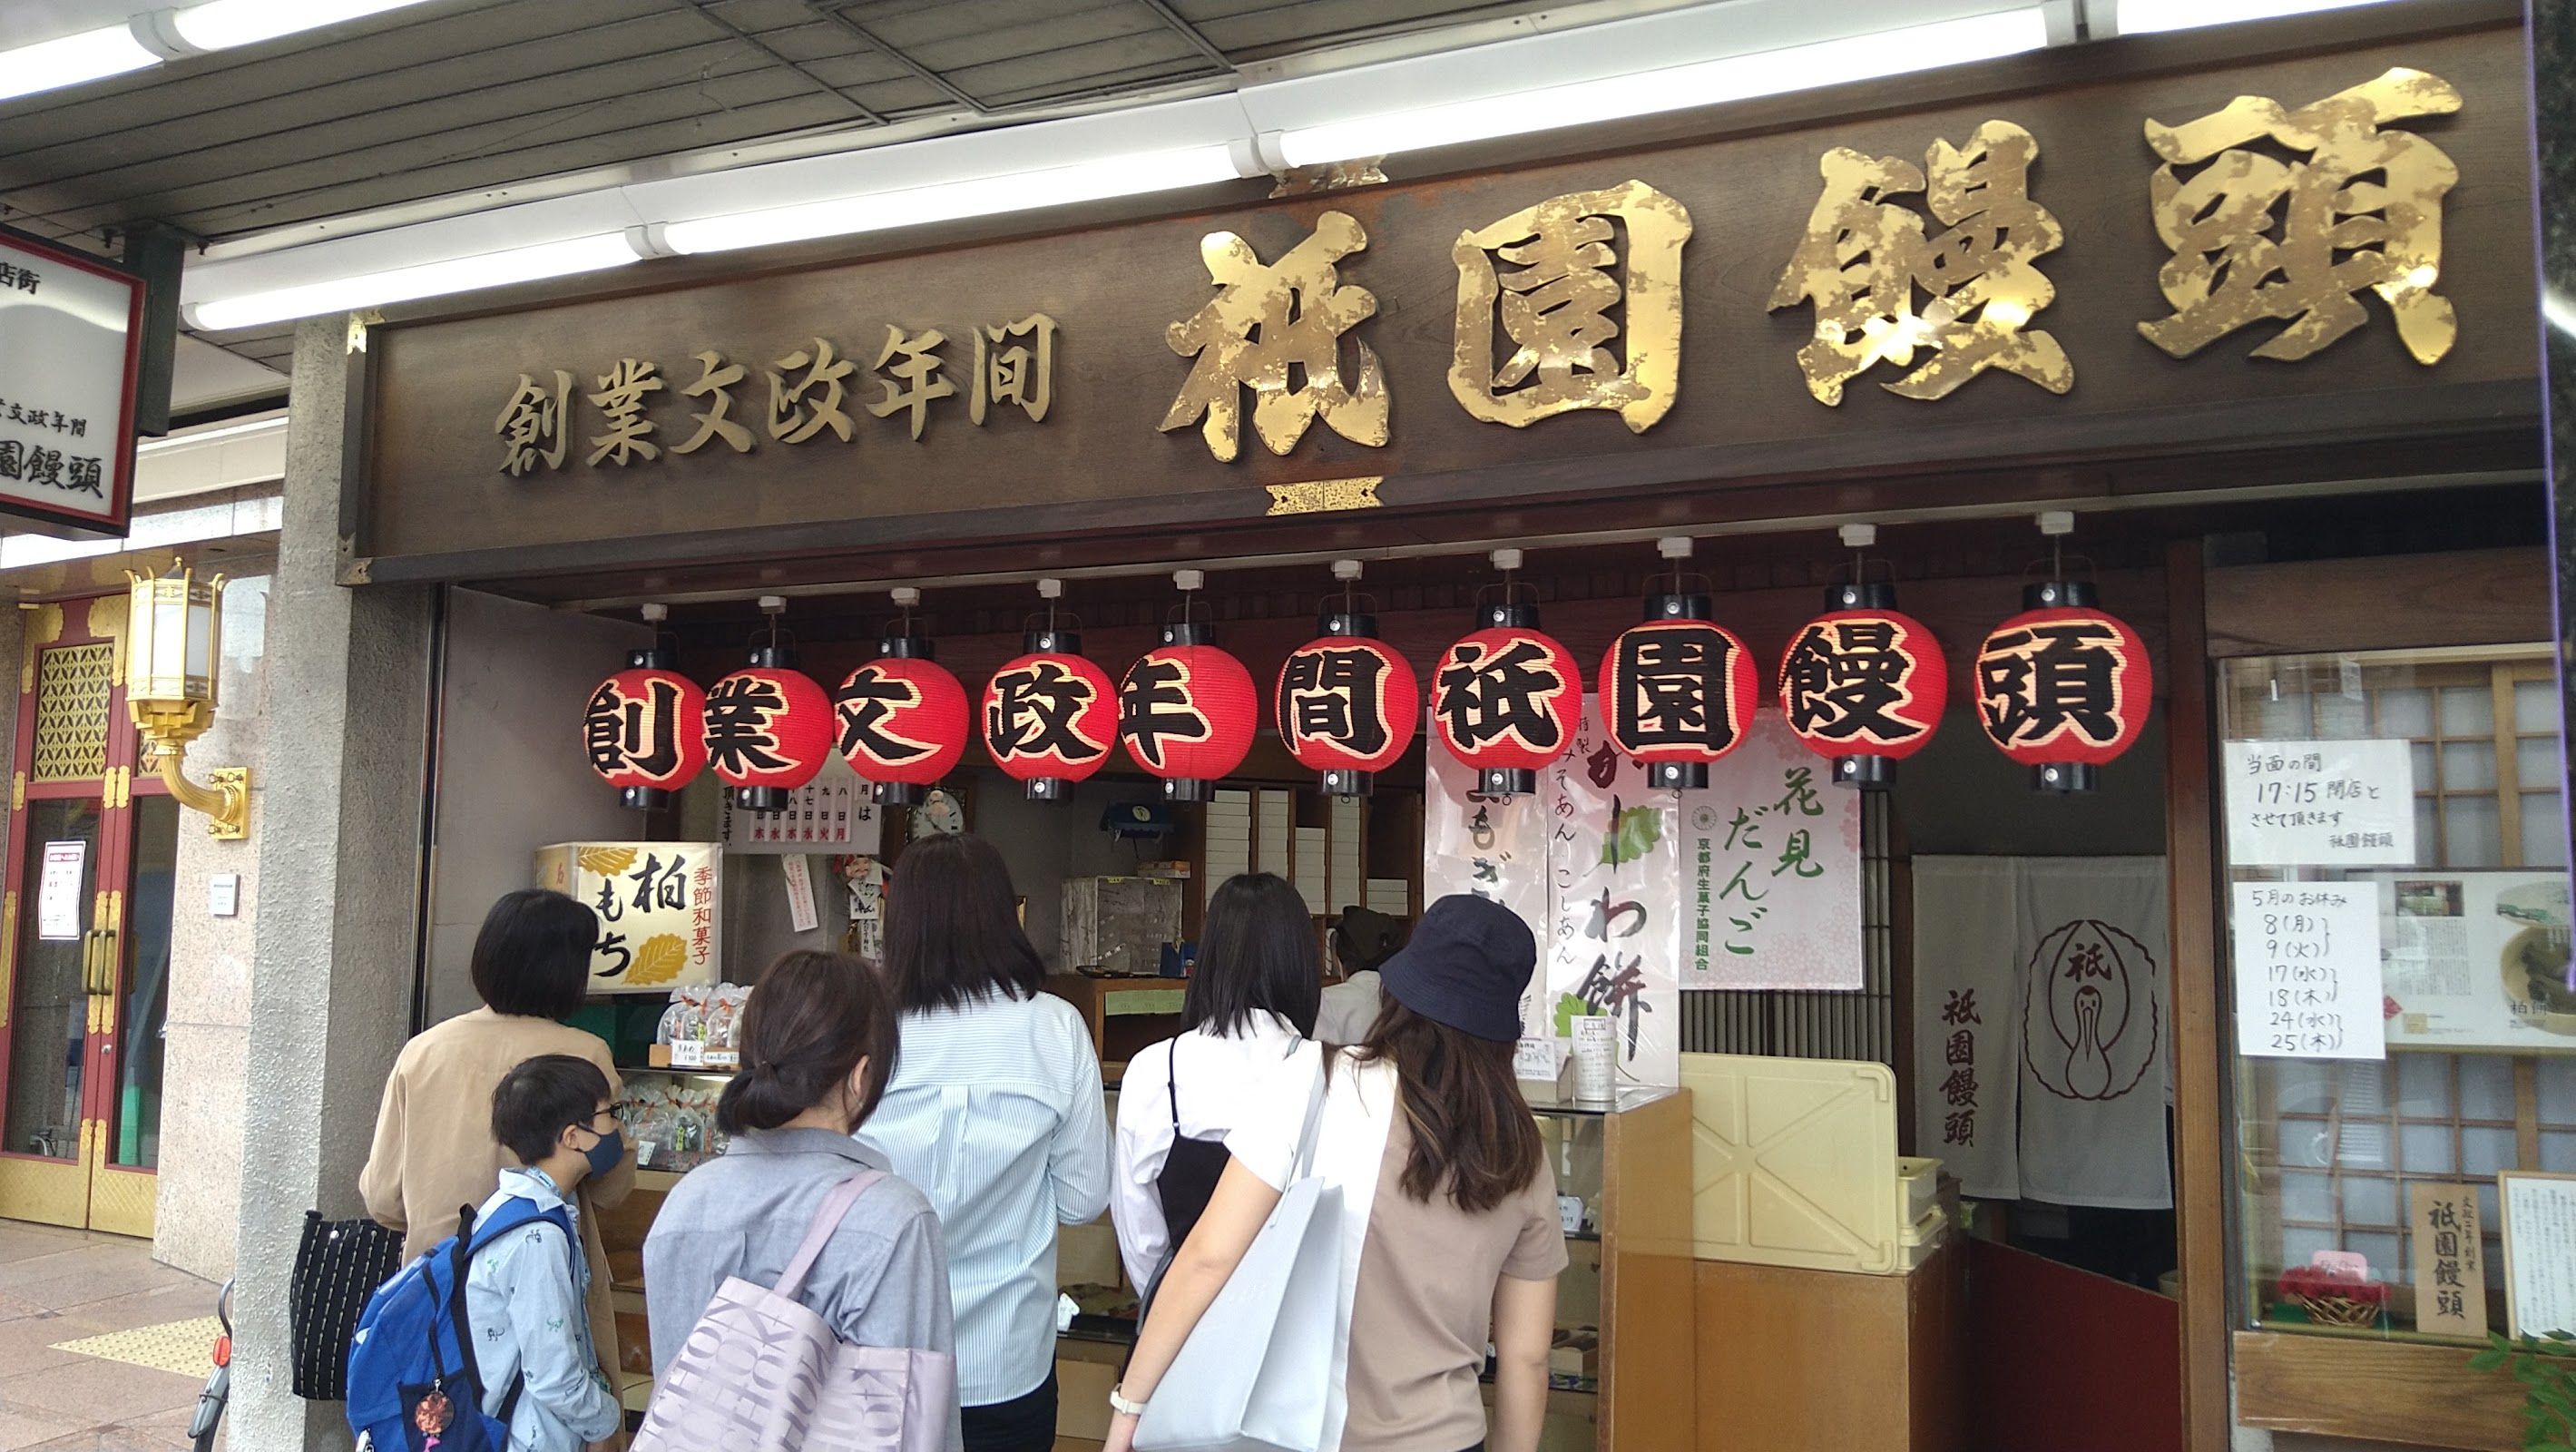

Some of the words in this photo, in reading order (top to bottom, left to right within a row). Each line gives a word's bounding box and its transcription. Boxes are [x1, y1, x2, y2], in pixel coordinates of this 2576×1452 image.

[1158, 66, 2463, 465] 祇園饅頭
[0, 398, 86, 437] 文政年間
[495, 312, 1061, 477] 創業文政年間
[2247, 752, 2322, 775] 当面の間
[2258, 781, 2317, 804] 17:15
[2326, 779, 2380, 800] 閉店と
[1773, 767, 1824, 878] 花見
[2250, 809, 2344, 828] させて頂きます
[593, 878, 632, 977] もち
[628, 852, 688, 913] 柏
[692, 866, 712, 966] 季節和菓子
[1695, 838, 1711, 971] 京都府生菓子協同組合
[1719, 806, 1769, 955] だんご
[1939, 987, 1982, 1148] 祇園饅頭
[2427, 1200, 2466, 1320] 祇園饅頭
